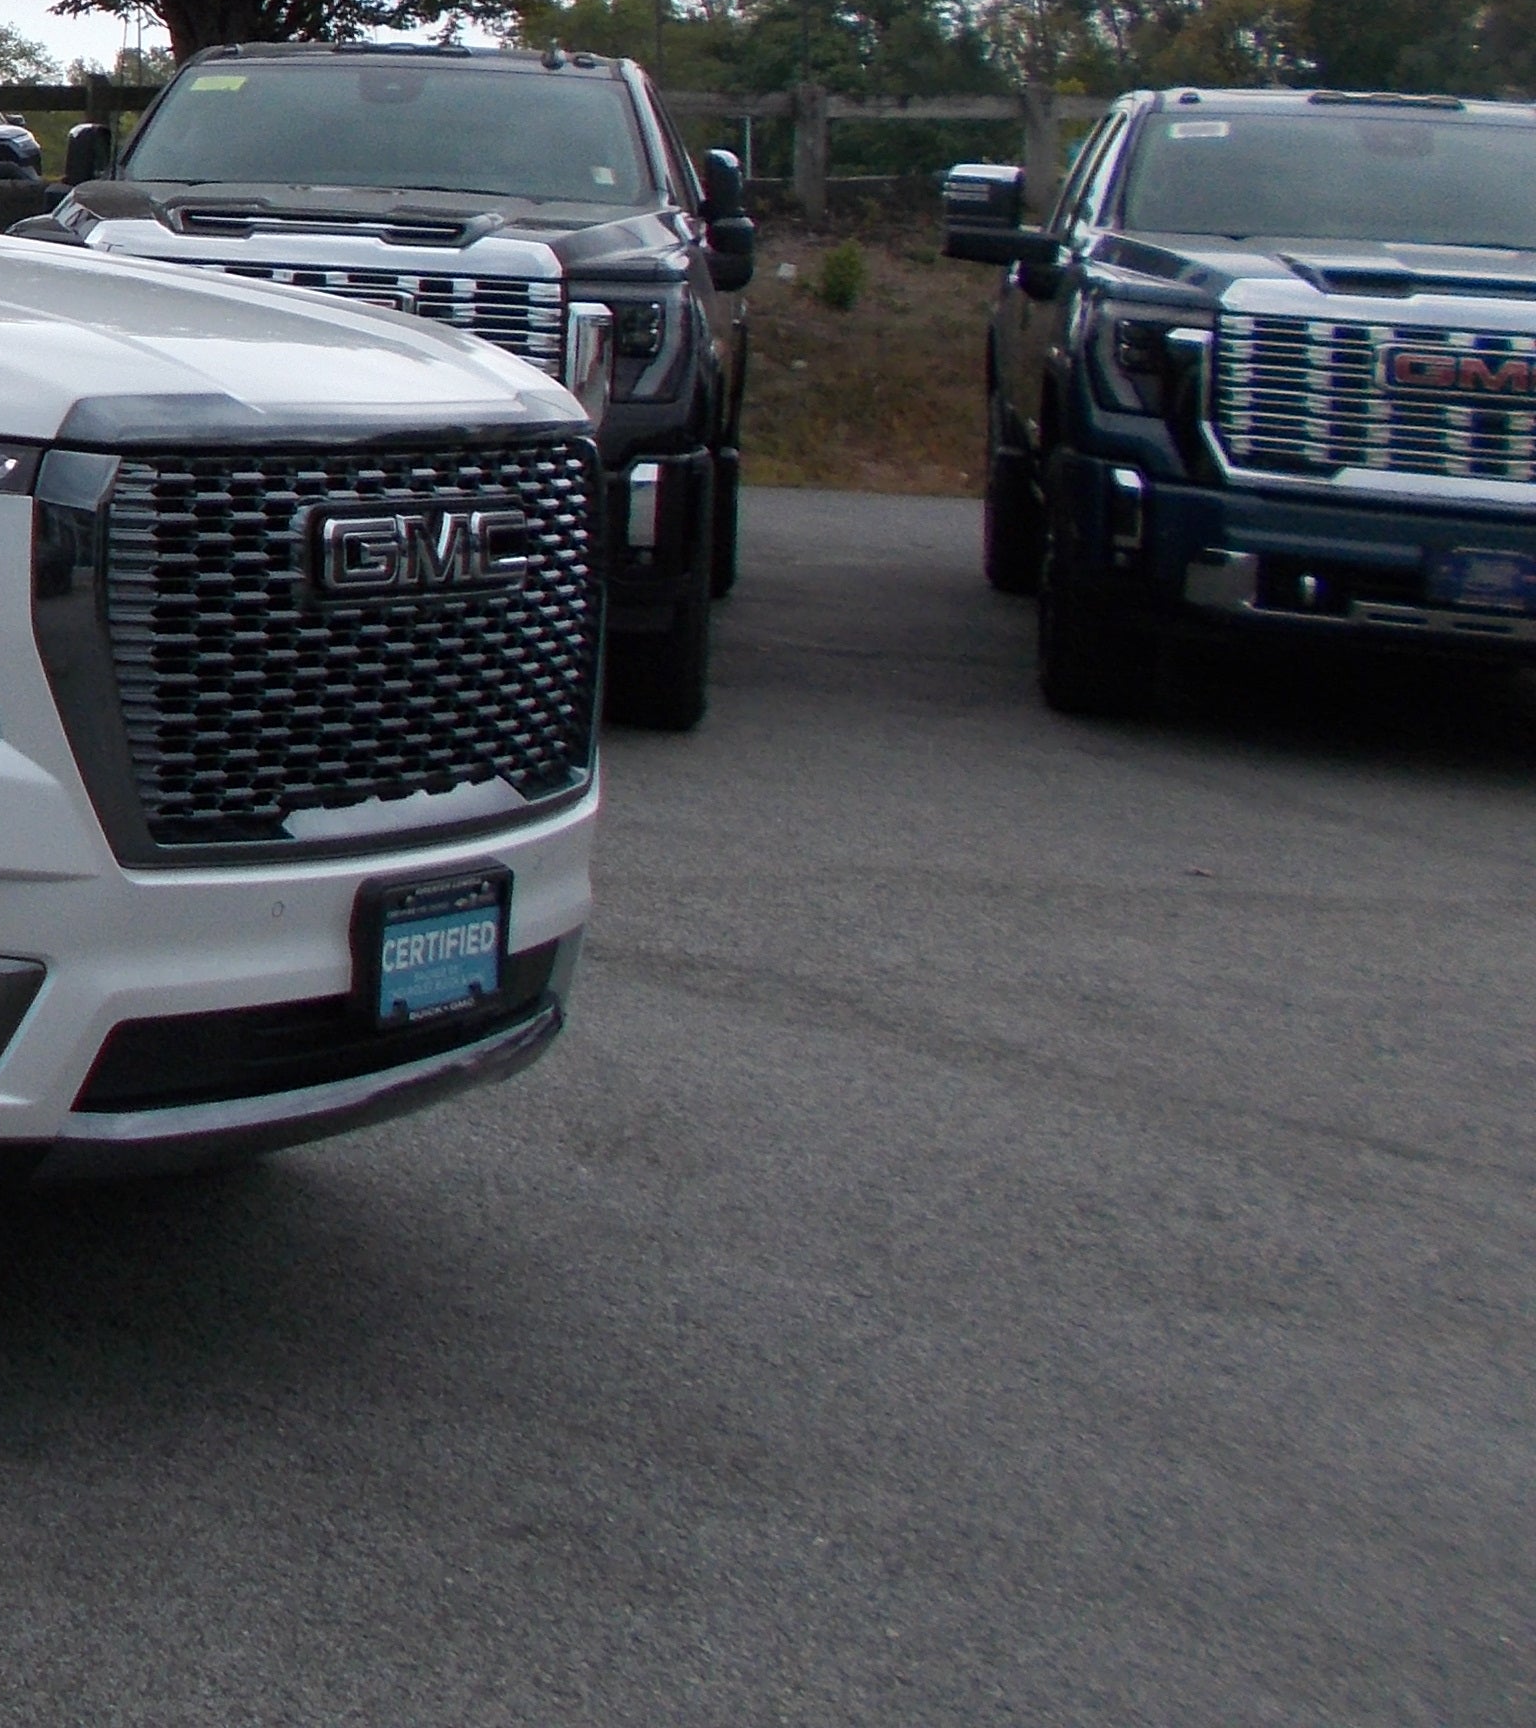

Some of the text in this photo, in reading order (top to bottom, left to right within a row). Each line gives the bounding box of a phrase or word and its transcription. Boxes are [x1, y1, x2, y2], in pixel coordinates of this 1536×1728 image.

[1394, 353, 1536, 393] GM
[323, 510, 528, 592] GMC
[382, 920, 496, 973] CERTIFIED
